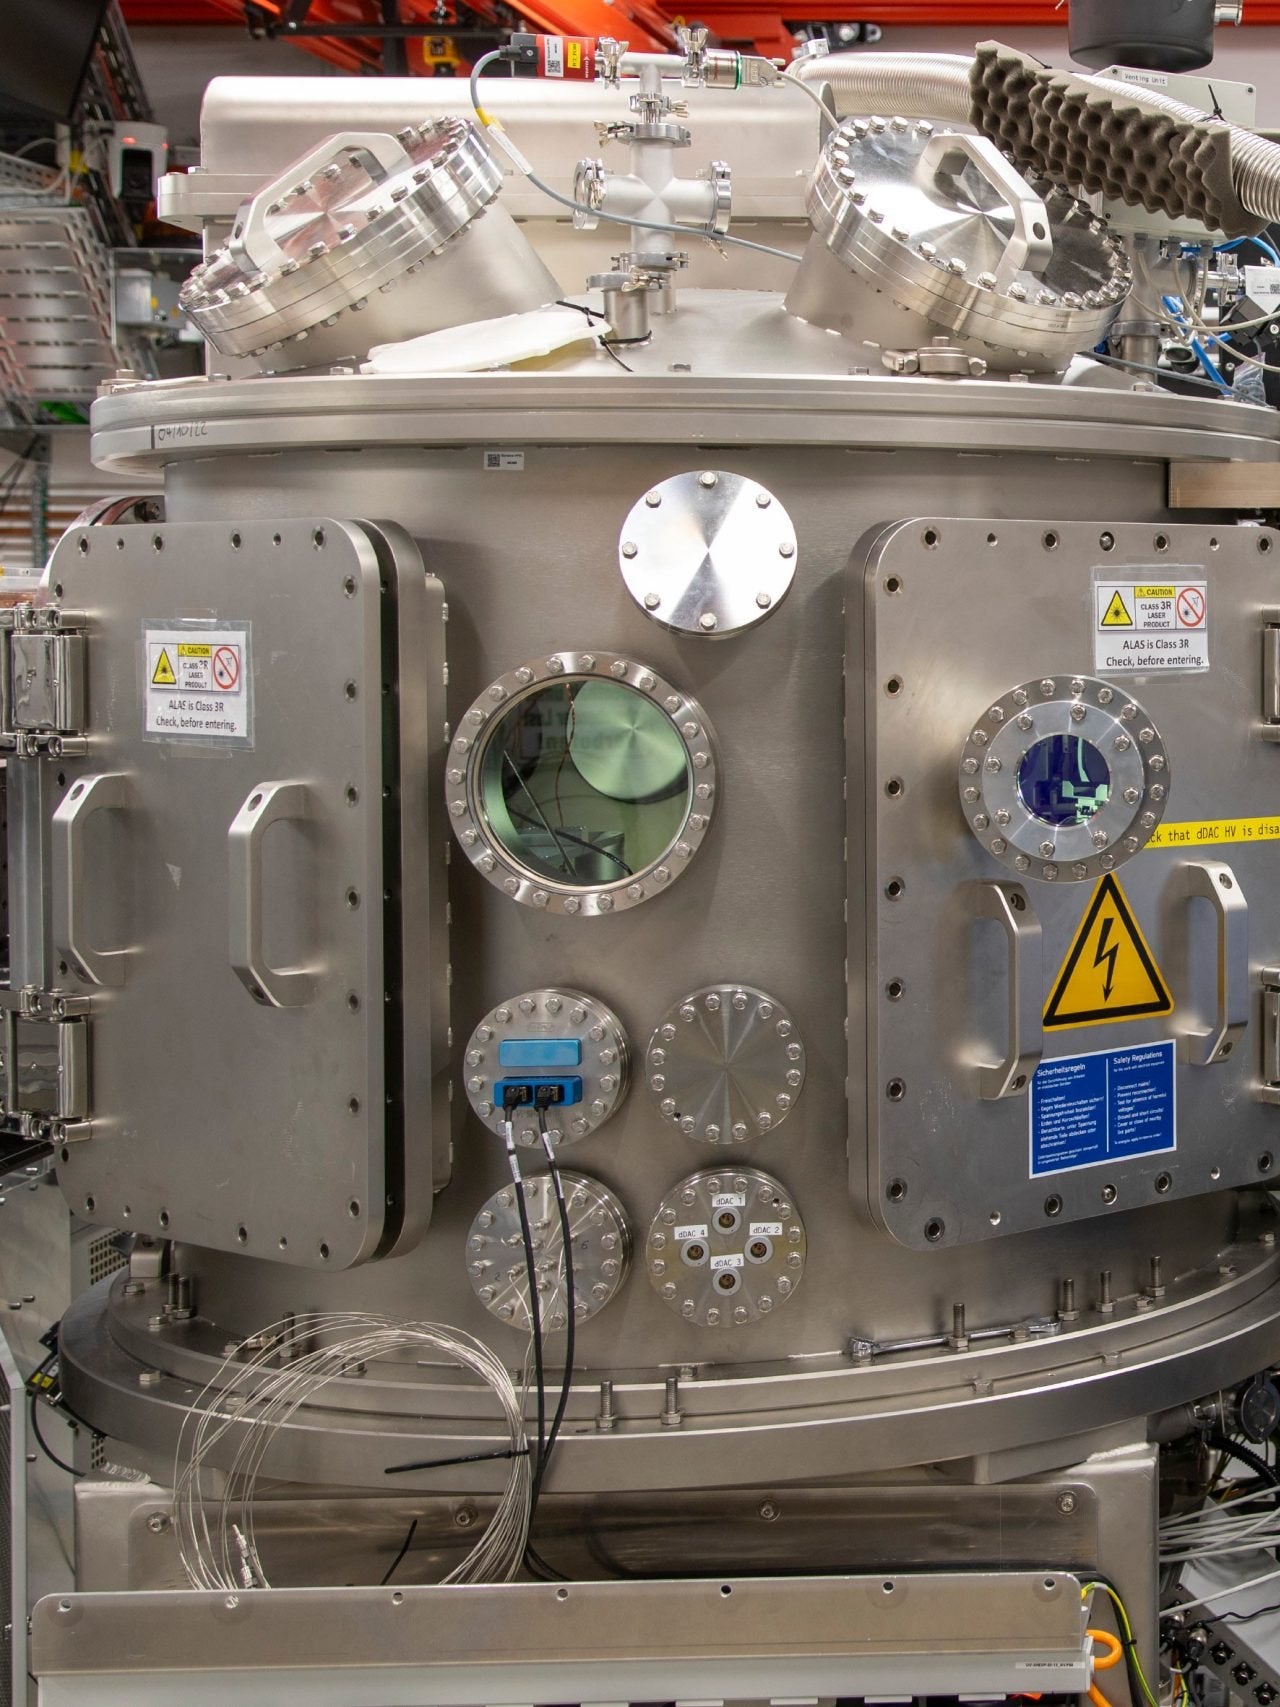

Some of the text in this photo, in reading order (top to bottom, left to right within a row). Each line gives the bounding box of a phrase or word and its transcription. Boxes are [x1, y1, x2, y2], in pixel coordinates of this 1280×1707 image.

[1146, 588, 1172, 596] CAUTION
[1160, 601, 1172, 610] 3R
[1123, 639, 1189, 650] ALAS is Class 3R
[1106, 654, 1204, 667] Check, before entering.
[188, 700, 193, 711] is
[195, 701, 213, 712] Class
[214, 702, 224, 712] 3R
[181, 716, 203, 728] before
[205, 719, 237, 733] entering.
[1146, 832, 1162, 843] ck
[1168, 830, 1190, 842] that
[1196, 826, 1220, 839] dDAC
[1225, 826, 1236, 837] HV
[1243, 825, 1252, 836] is
[1113, 1051, 1162, 1065] Safety Regulations
[1037, 1063, 1086, 1077] Sicherheitsregeln
[753, 1226, 780, 1234] dDAC 2
